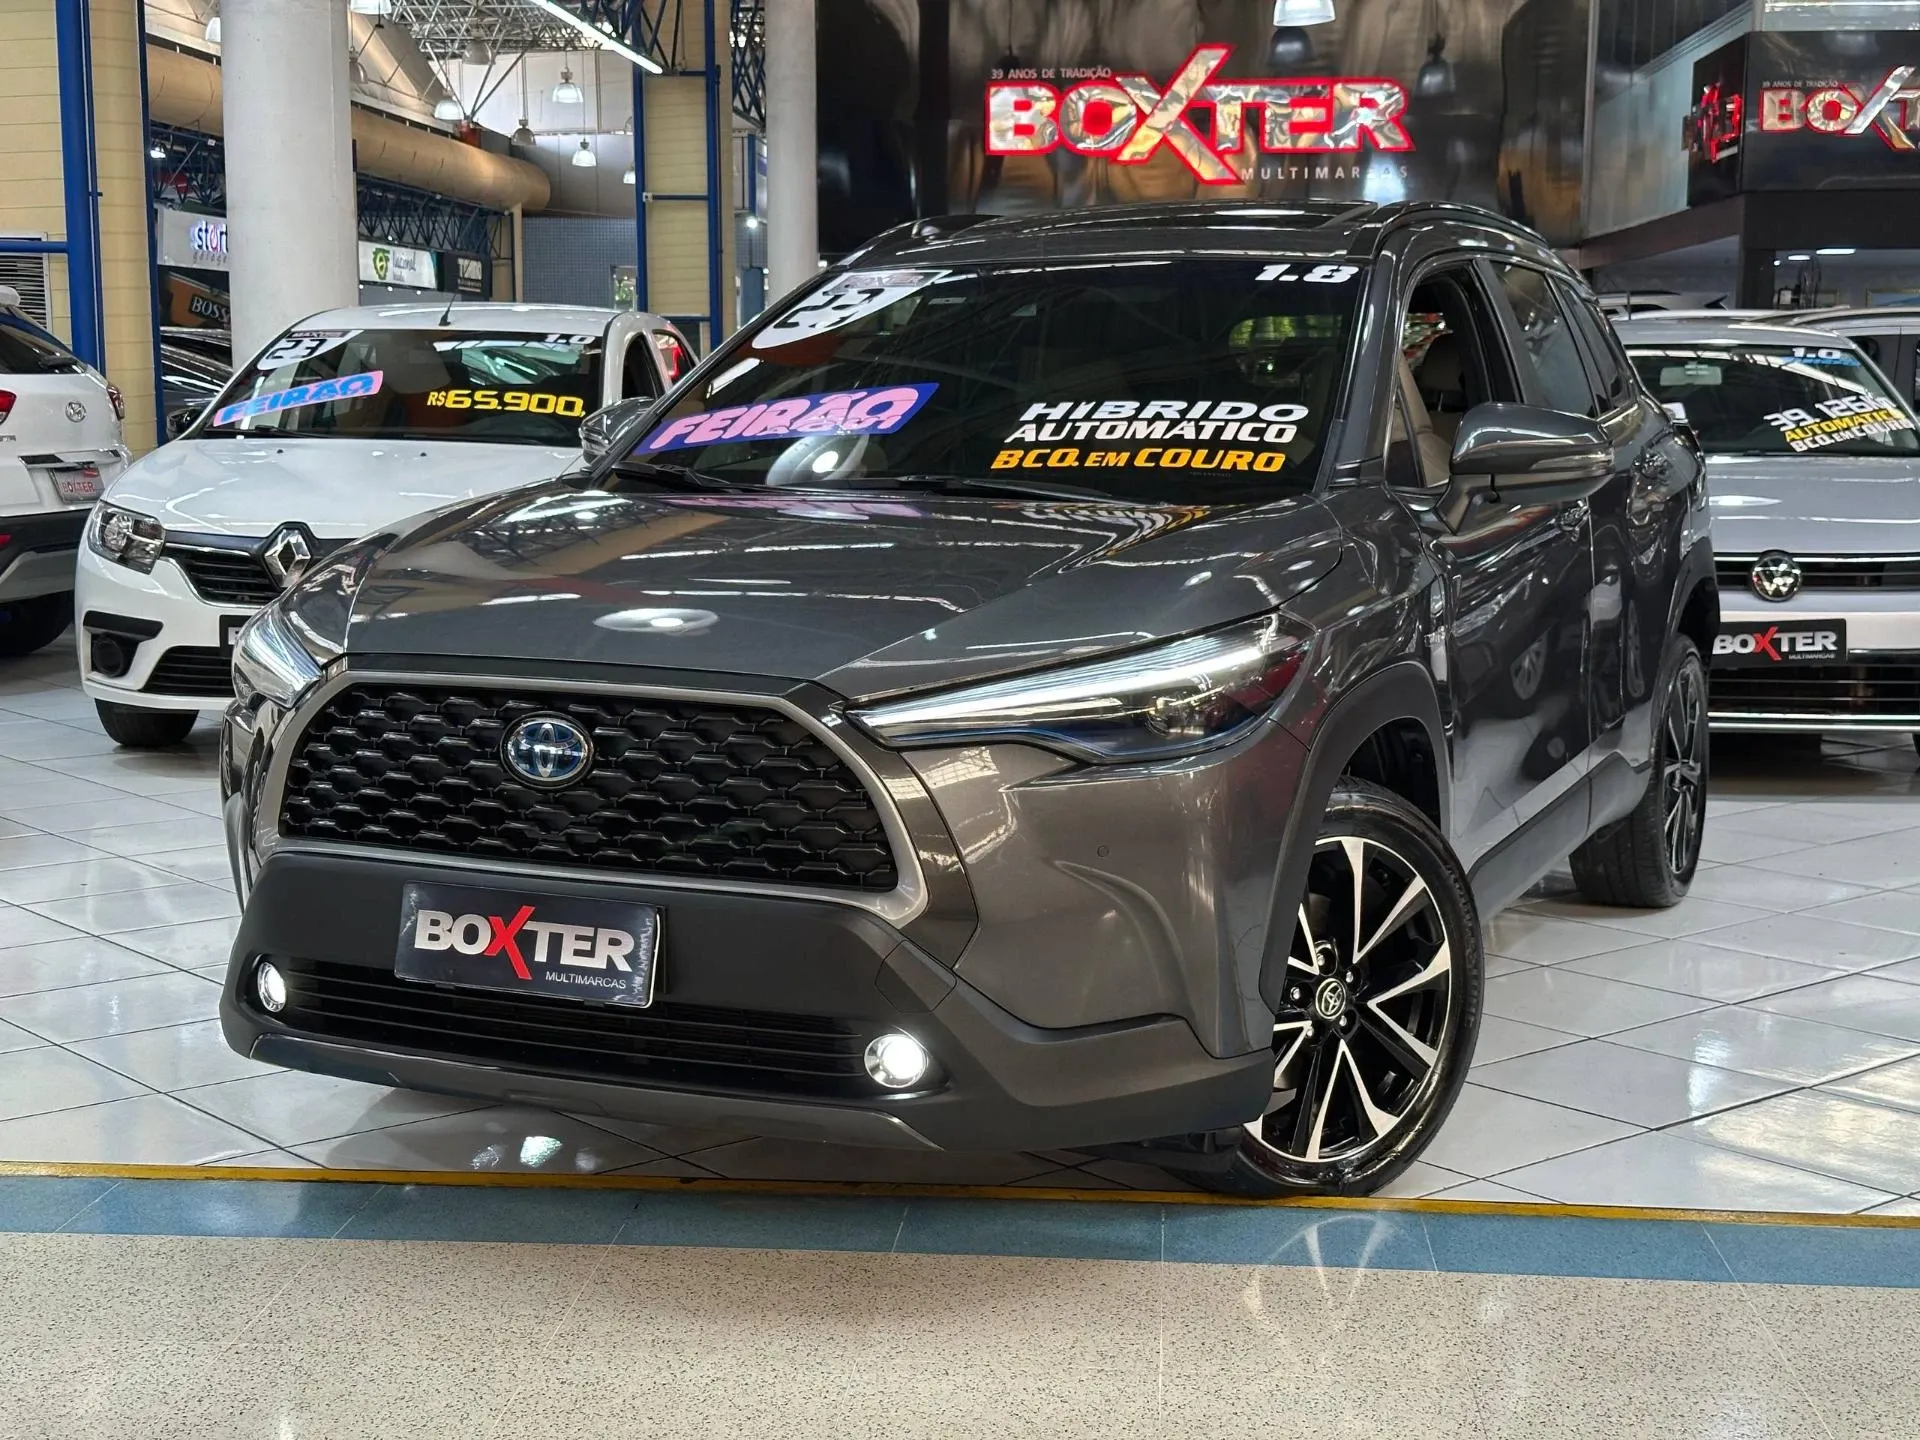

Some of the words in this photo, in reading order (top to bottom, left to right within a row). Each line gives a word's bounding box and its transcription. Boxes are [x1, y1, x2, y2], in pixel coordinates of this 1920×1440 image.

[991, 68, 1004, 79] 39
[1007, 68, 1038, 80] ANOS
[1041, 68, 1056, 79] DE
[1060, 64, 1112, 80] TRADIÇÃO
[985, 43, 1416, 185] BOXTER
[1255, 263, 1360, 283] 1.8
[265, 338, 328, 360] 23
[1791, 346, 1842, 360] 1.0
[1084, 451, 1132, 467] EM
[1133, 448, 1286, 473] COURO
[1712, 626, 1838, 661] BOXTER
[414, 905, 634, 980] BOXTER
[546, 971, 627, 989] MULTIMARCAS
